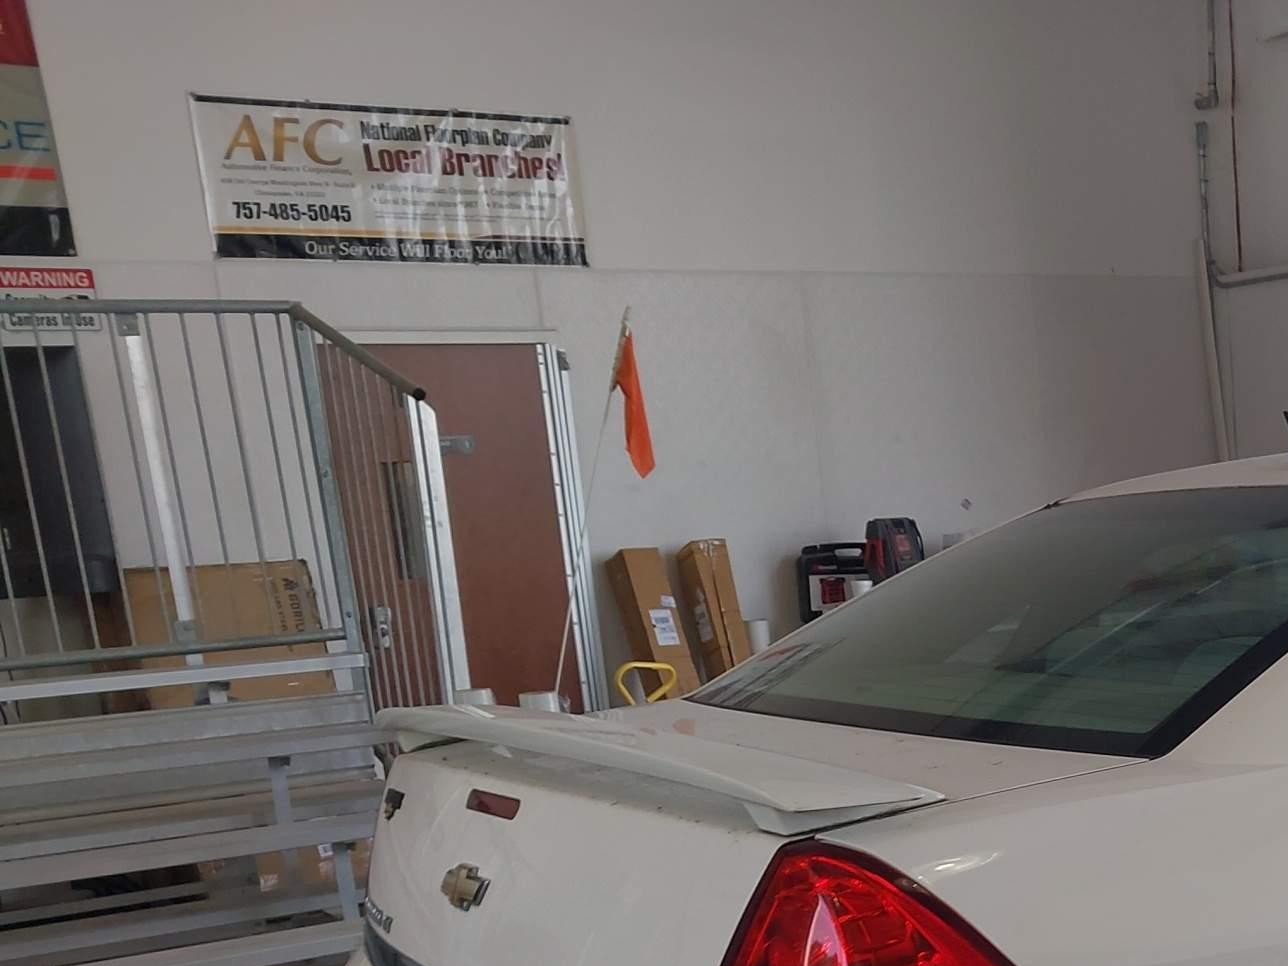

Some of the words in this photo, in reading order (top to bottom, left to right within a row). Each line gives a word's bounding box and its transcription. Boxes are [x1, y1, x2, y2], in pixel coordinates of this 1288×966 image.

[224, 114, 344, 166] AFC
[360, 121, 420, 142] National
[362, 143, 433, 175] Local
[441, 146, 566, 181] Branches!
[232, 201, 352, 222] 757-485-5045
[305, 240, 337, 255] Our
[339, 242, 399, 257] Service
[400, 243, 430, 258] Will
[433, 243, 472, 259] Floor
[0, 270, 89, 287] WARNING
